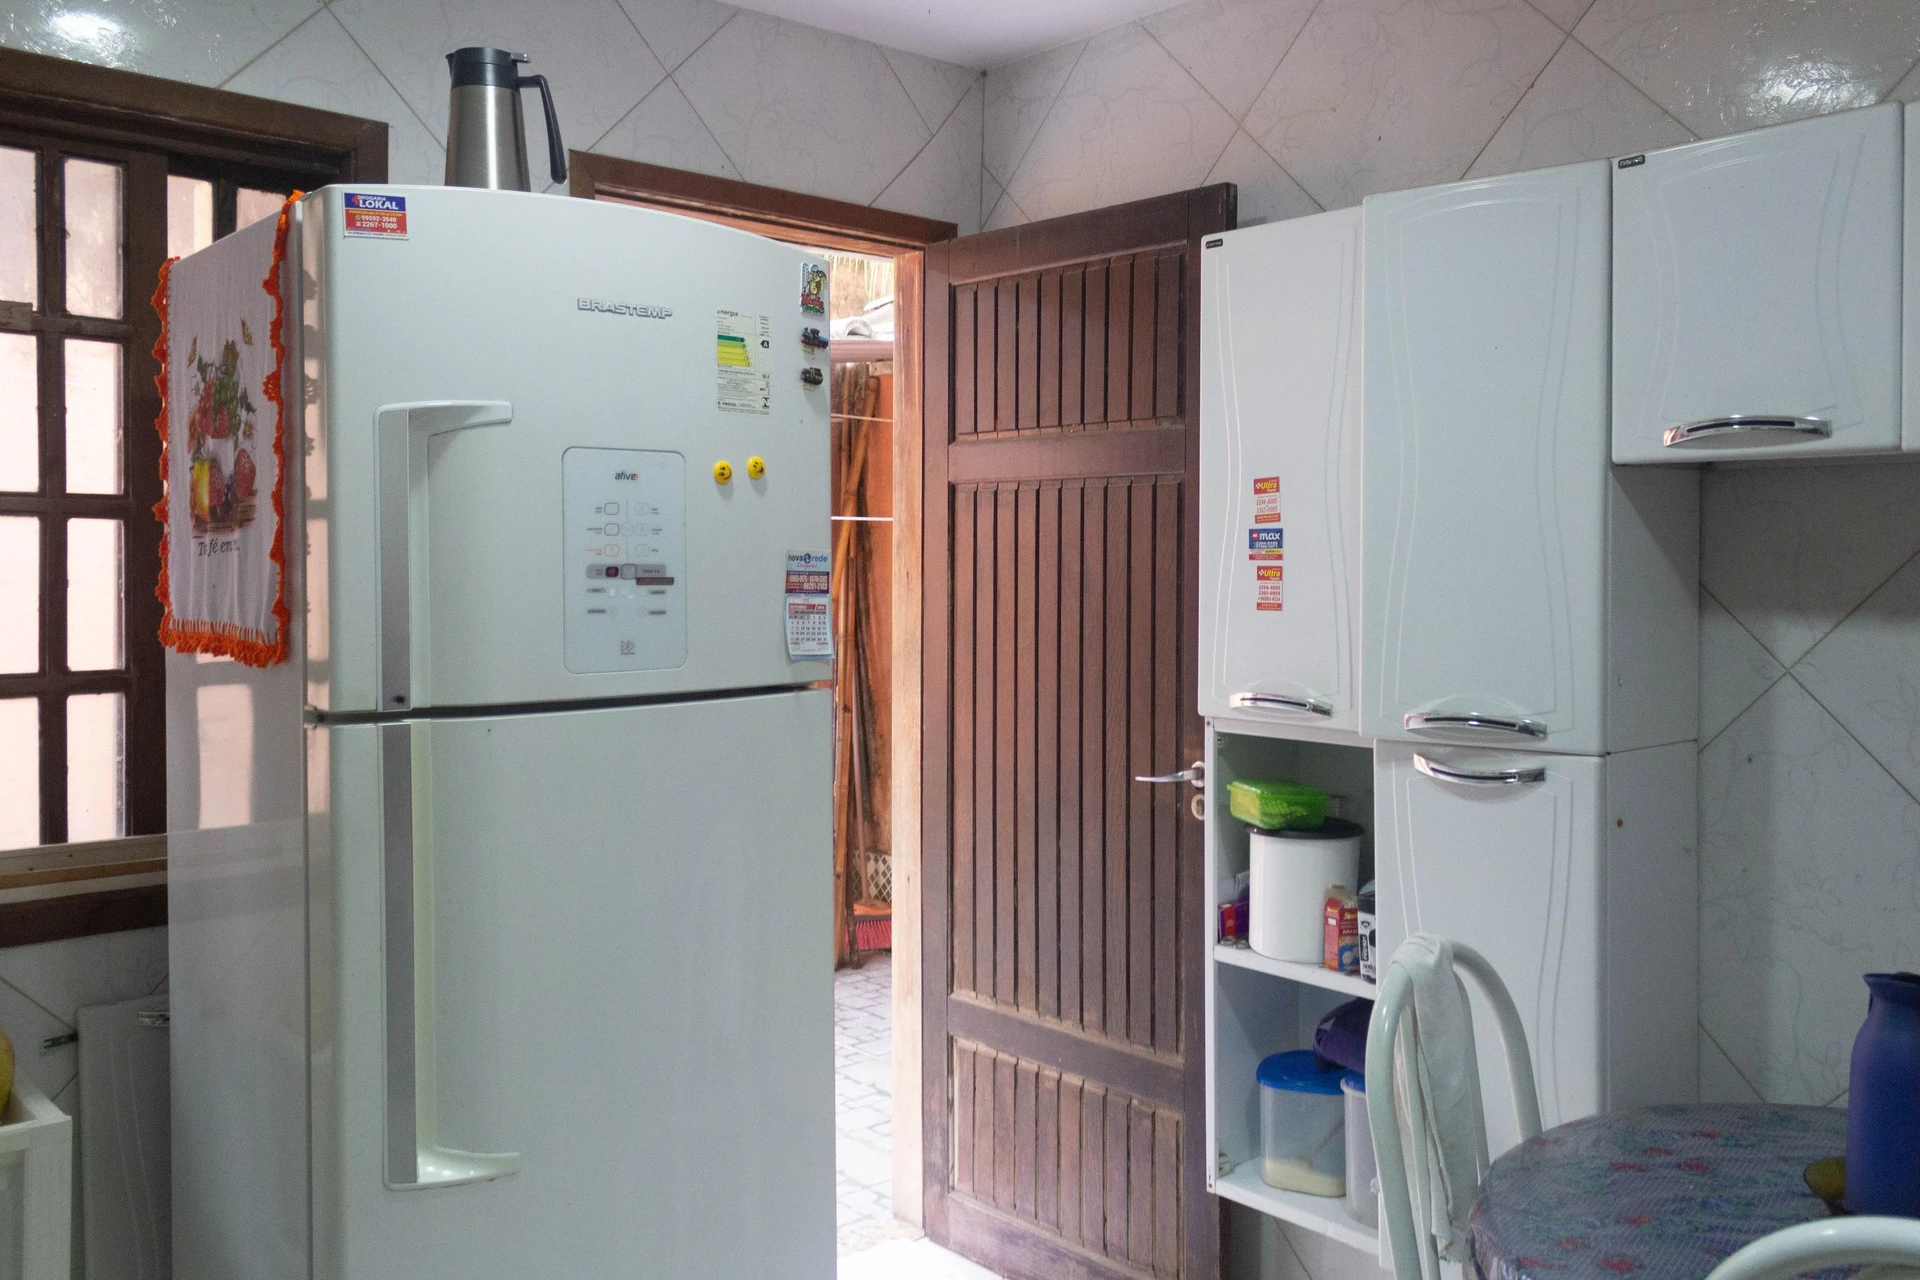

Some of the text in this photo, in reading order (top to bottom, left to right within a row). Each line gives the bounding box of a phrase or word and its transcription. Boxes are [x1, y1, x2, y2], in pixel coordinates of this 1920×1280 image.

[360, 200, 399, 210] LOKAL
[362, 221, 398, 229] 2267-1000
[577, 298, 673, 319] BRASTEMP
[1261, 482, 1277, 490] Ultra
[1260, 532, 1281, 541] max
[1264, 569, 1280, 577] Ultra
